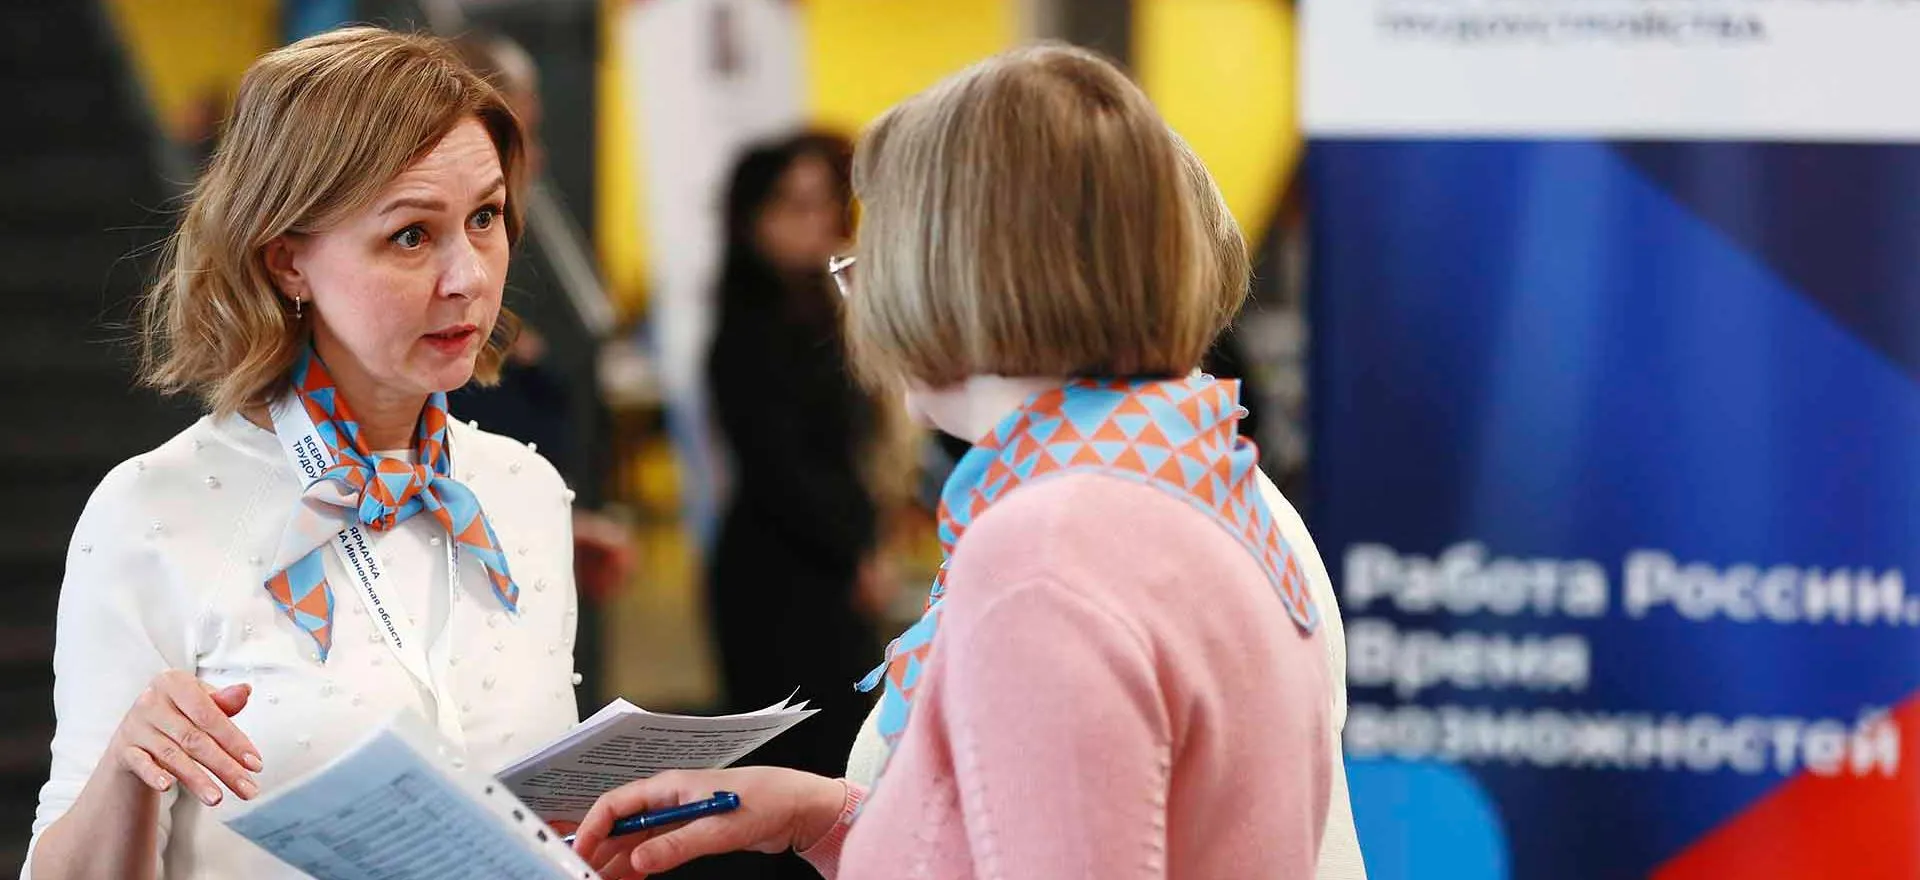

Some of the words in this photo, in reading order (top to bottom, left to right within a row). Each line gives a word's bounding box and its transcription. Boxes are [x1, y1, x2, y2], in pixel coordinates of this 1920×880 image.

[292, 440, 318, 478] ТРУДОУ
[349, 526, 380, 580] ЯРМАРКА
[1344, 543, 1607, 615] Работа
[1622, 550, 1920, 626] России.
[345, 543, 380, 606] Ивановская
[378, 607, 403, 649] область
[1347, 618, 1590, 695] Время
[1345, 703, 1900, 778] возможностей
